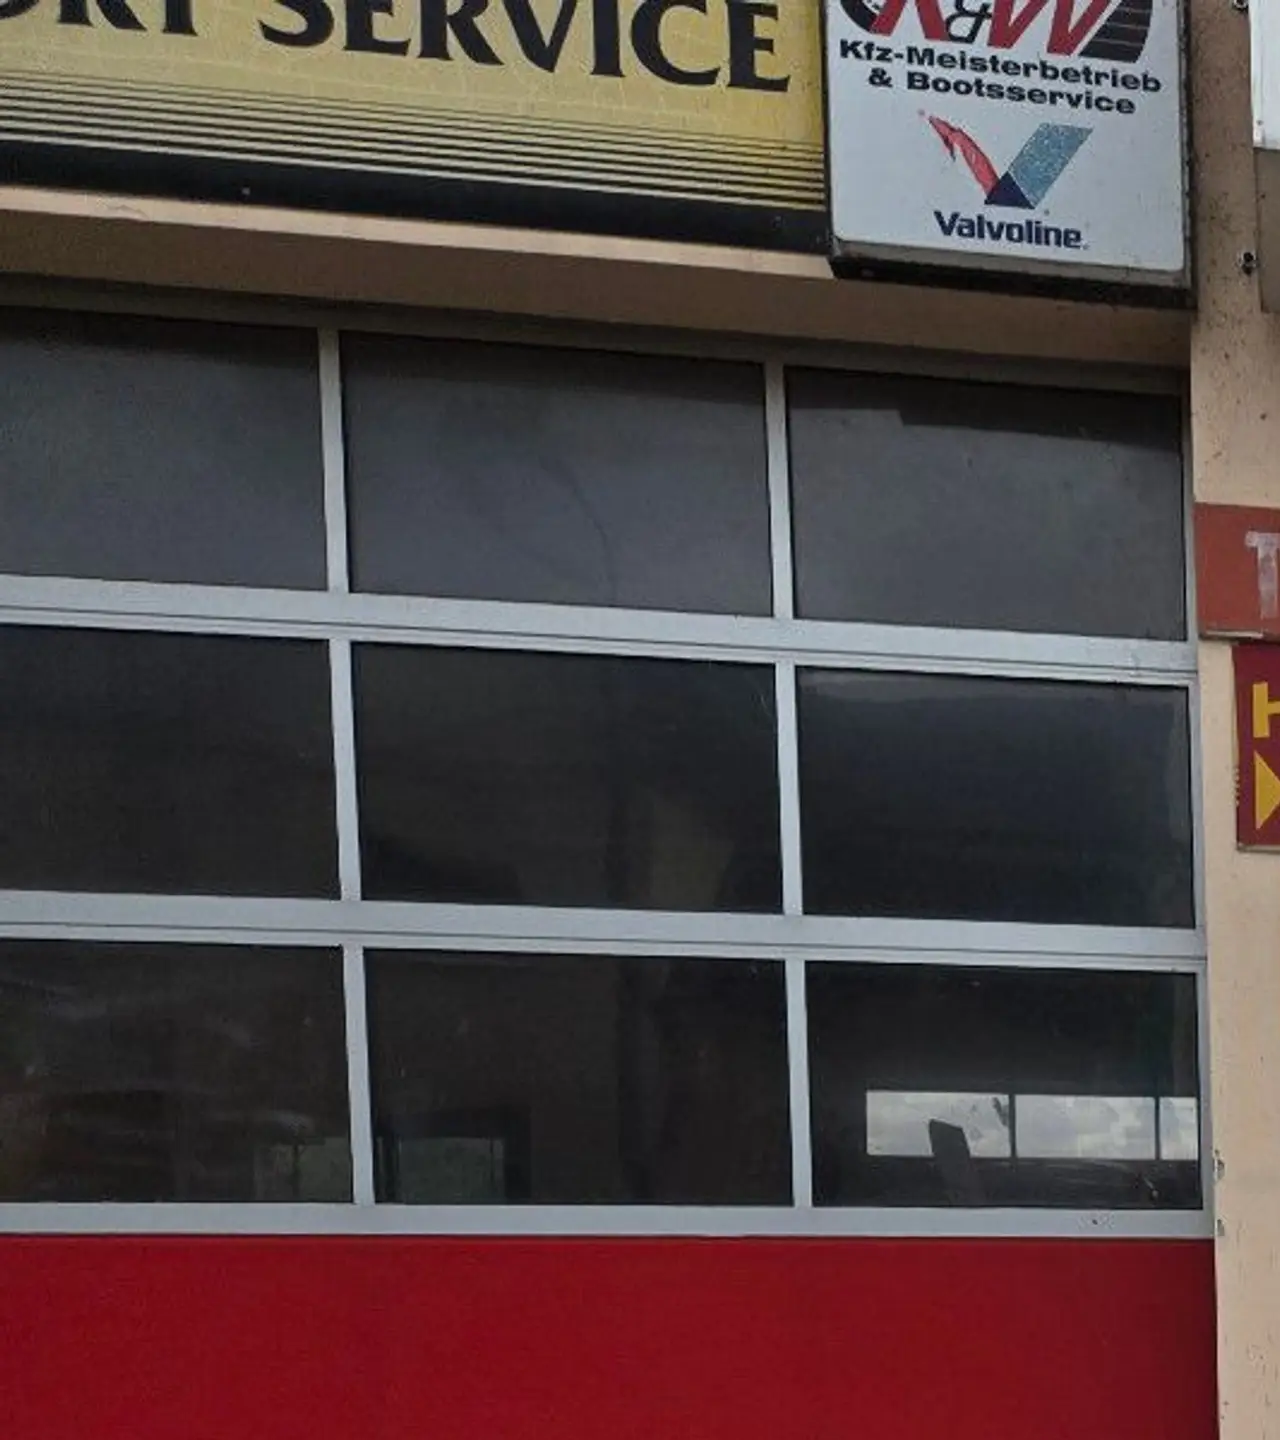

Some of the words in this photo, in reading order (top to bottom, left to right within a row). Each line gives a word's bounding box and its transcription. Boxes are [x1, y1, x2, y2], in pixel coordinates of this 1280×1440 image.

[259, 0, 790, 92] SERVICE
[840, 39, 1162, 93] Kfz-Meisterbetrieb
[868, 67, 893, 89] &
[906, 71, 1136, 115] Bootsservice
[933, 210, 1083, 250] Valvoline
